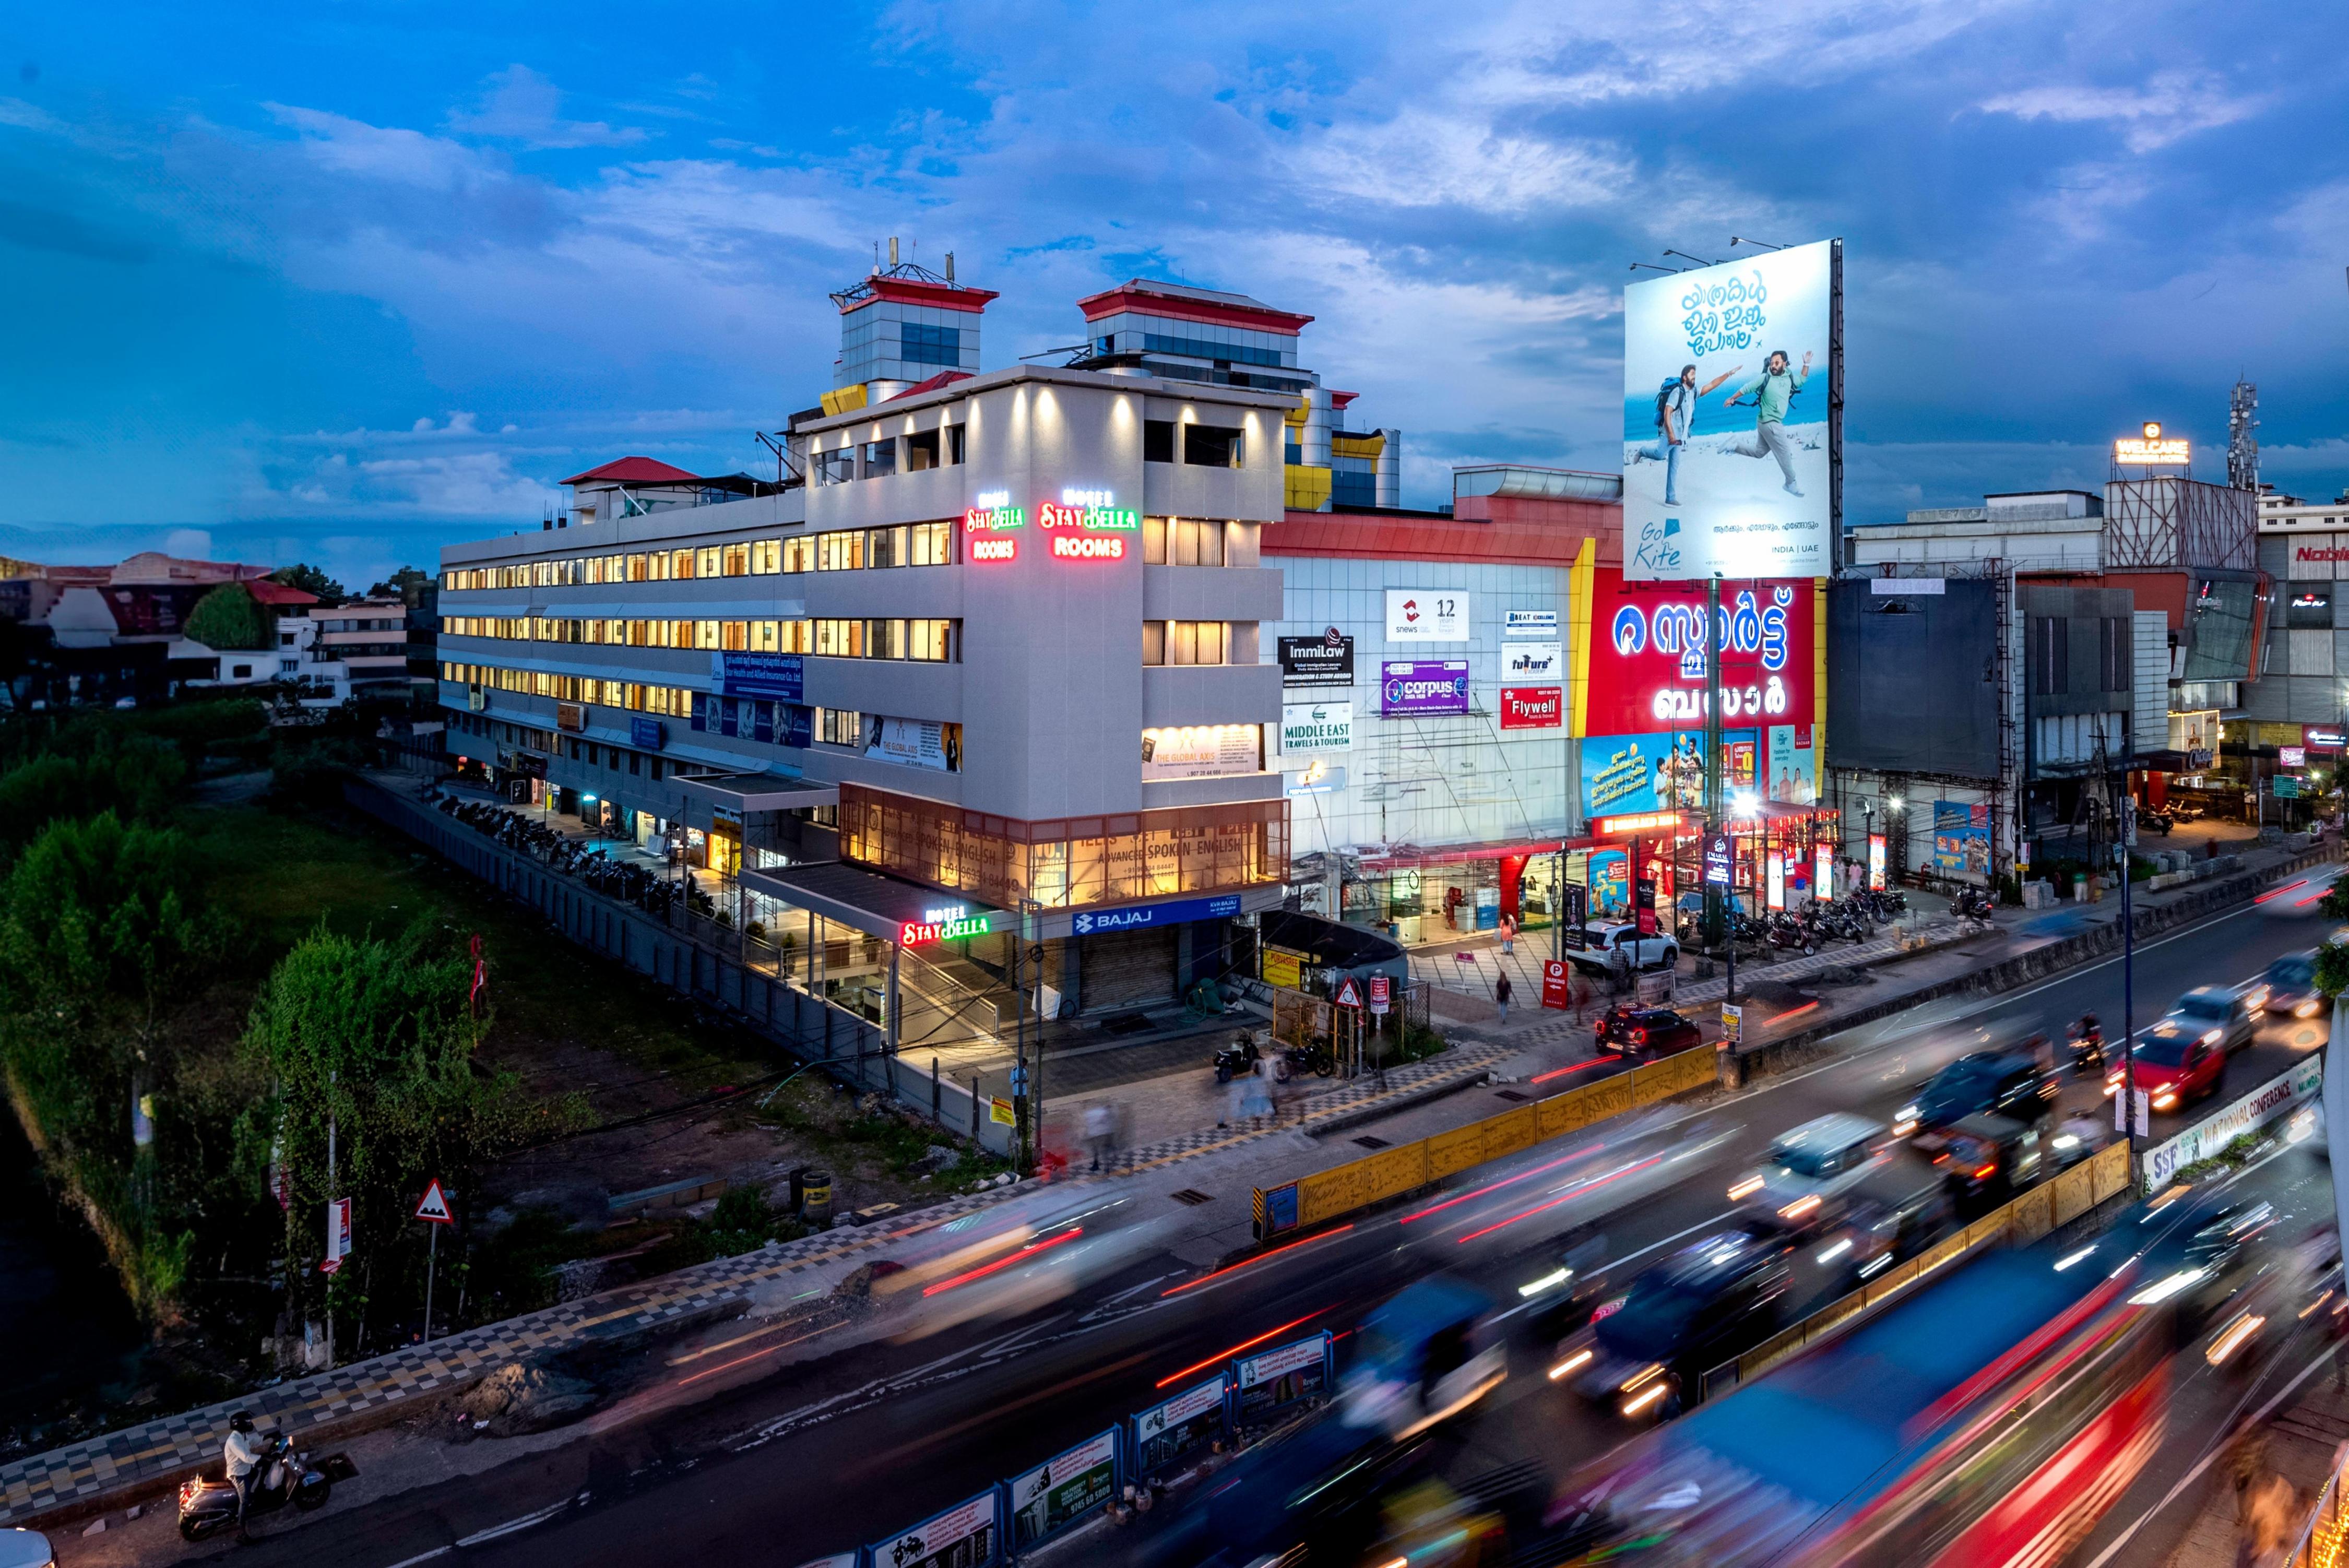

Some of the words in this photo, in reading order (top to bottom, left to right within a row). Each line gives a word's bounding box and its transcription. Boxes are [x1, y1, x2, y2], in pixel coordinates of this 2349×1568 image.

[1681, 310, 1718, 337] ഇനി
[2117, 440, 2188, 454] WELCARE
[1063, 489, 1114, 506] HOTEL
[1642, 522, 1662, 540] Go
[974, 540, 1014, 559] ROOMS
[1054, 537, 1122, 557] ROOMS
[1802, 544, 1819, 553] UAE
[1633, 543, 1680, 569] Kite
[1438, 599, 1455, 617] 12
[1290, 645, 1345, 658] ImmiLaw
[733, 668, 746, 677] Health
[754, 669, 765, 679] Allied
[766, 671, 786, 681] Insurance
[793, 672, 802, 682] Ltd.
[1405, 681, 1453, 697] corpus
[1512, 699, 1555, 717] Flywell
[1285, 725, 1324, 739] MIDDLE
[1327, 723, 1349, 735] EAST
[892, 742, 907, 753] GLOBAL
[908, 744, 918, 754] AXIS
[1285, 739, 1313, 748] TRAVELS
[1321, 738, 1349, 746] TOURISM
[1156, 754, 1169, 763] THE
[1171, 753, 1197, 762] GLOBAL
[1200, 752, 1215, 761] AXIS
[916, 831, 950, 854] SPOKEN
[956, 841, 995, 866] ENGLISH
[1098, 849, 1143, 864] ADVANCED
[1148, 842, 1190, 859] SPOKEN
[1197, 838, 1241, 855] ENGLISH
[926, 906, 966, 924] HOTEL
[1098, 910, 1152, 928] BAJAJ
[1271, 953, 1298, 968] PURVASREE
[1553, 966, 1561, 974] P
[1546, 977, 1565, 985] PARKING
[2154, 1143, 2178, 1179] SSF
[2204, 1105, 2249, 1144] NATIONAL
[2250, 1079, 2291, 1118] CONFERENCE
[1069, 1480, 1086, 1492] PERFECT
[1071, 1499, 1085, 1514] 9745
[1086, 1494, 1094, 1505] 60
[1095, 1484, 1110, 1501] 5000
[1073, 1489, 1087, 1501] FAMILY
